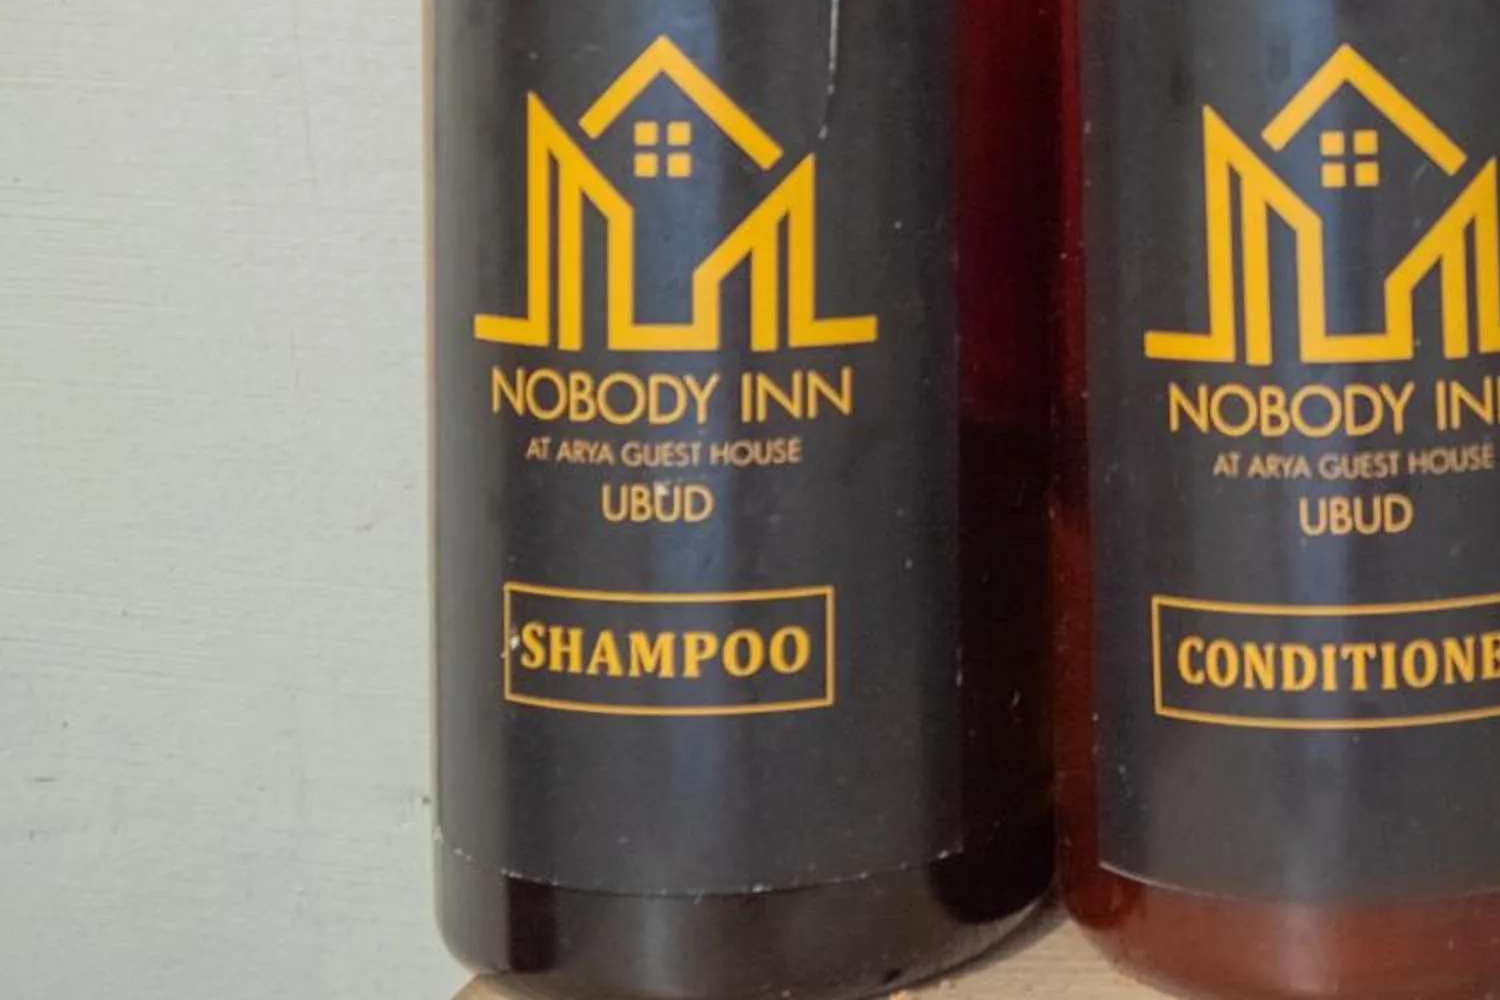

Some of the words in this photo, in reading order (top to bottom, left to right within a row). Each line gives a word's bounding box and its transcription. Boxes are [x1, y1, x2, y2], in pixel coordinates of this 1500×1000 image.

[492, 366, 720, 425] NOBODY
[741, 366, 852, 422] INN
[1169, 381, 1415, 438] NOBODY
[525, 437, 551, 461] AT
[556, 440, 614, 465] ARYA
[621, 441, 701, 467] GUEST
[710, 437, 802, 466] HOUSE
[1212, 452, 1241, 477] AT
[1247, 454, 1311, 479] ARYA
[1318, 452, 1400, 480] GUEST
[1408, 444, 1496, 475] HOUSE
[601, 484, 713, 522] UBUD
[1300, 494, 1414, 536] UBUD
[520, 621, 811, 678] SHAMPOO
